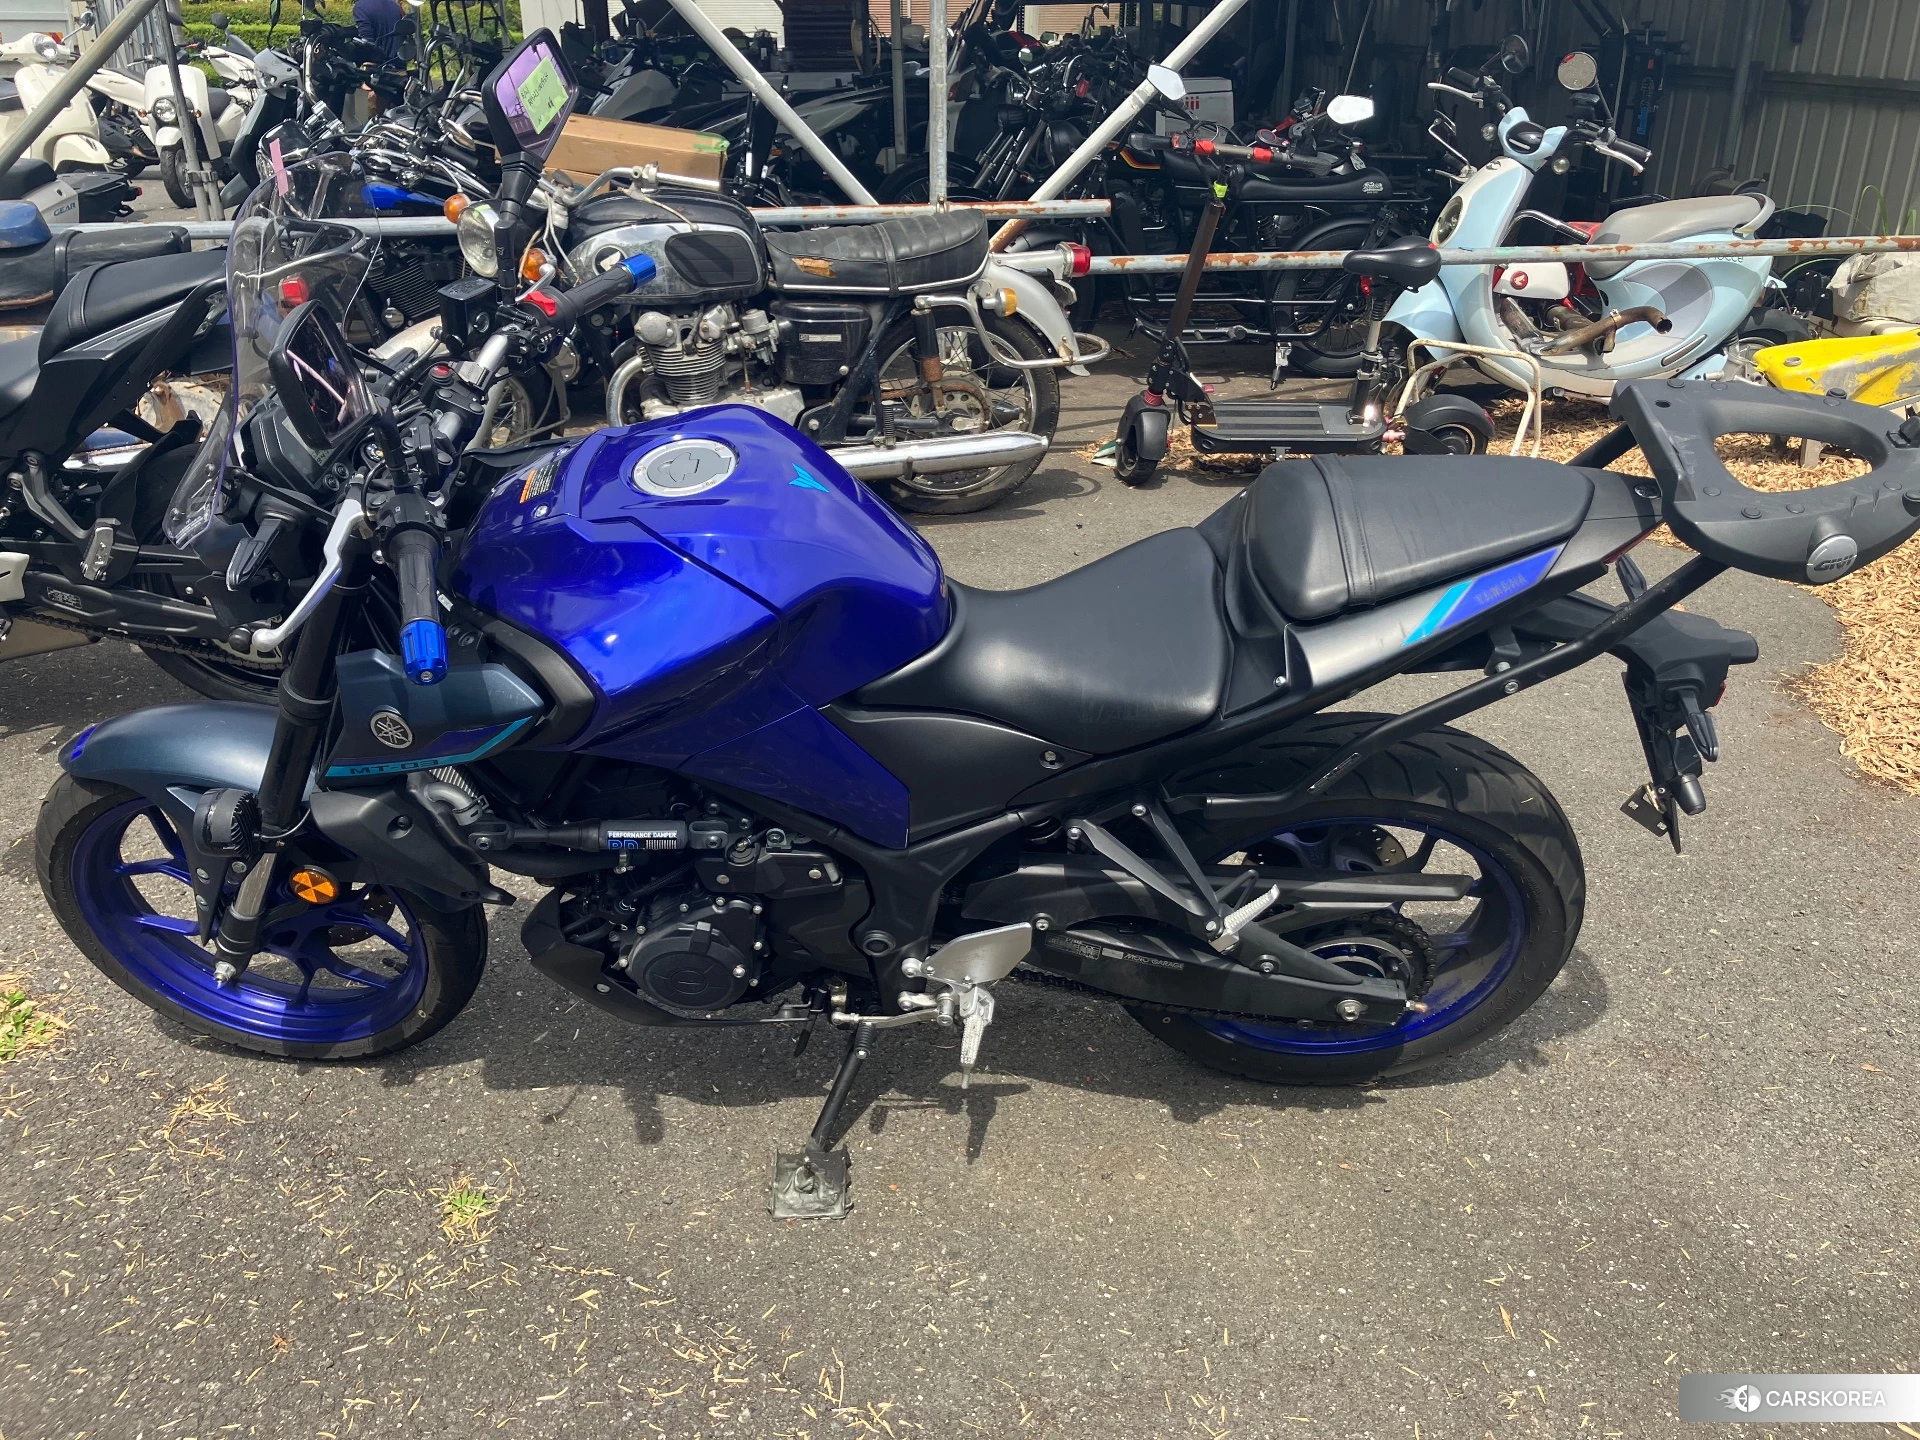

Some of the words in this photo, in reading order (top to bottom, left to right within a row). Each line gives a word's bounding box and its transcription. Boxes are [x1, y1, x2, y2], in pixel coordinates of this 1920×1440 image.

[53, 202, 76, 217] GEAR
[1813, 553, 1855, 571] GIVI
[349, 759, 439, 775] MT-03
[607, 830, 651, 839] PERFORMANCE
[652, 830, 677, 839] DAMPER
